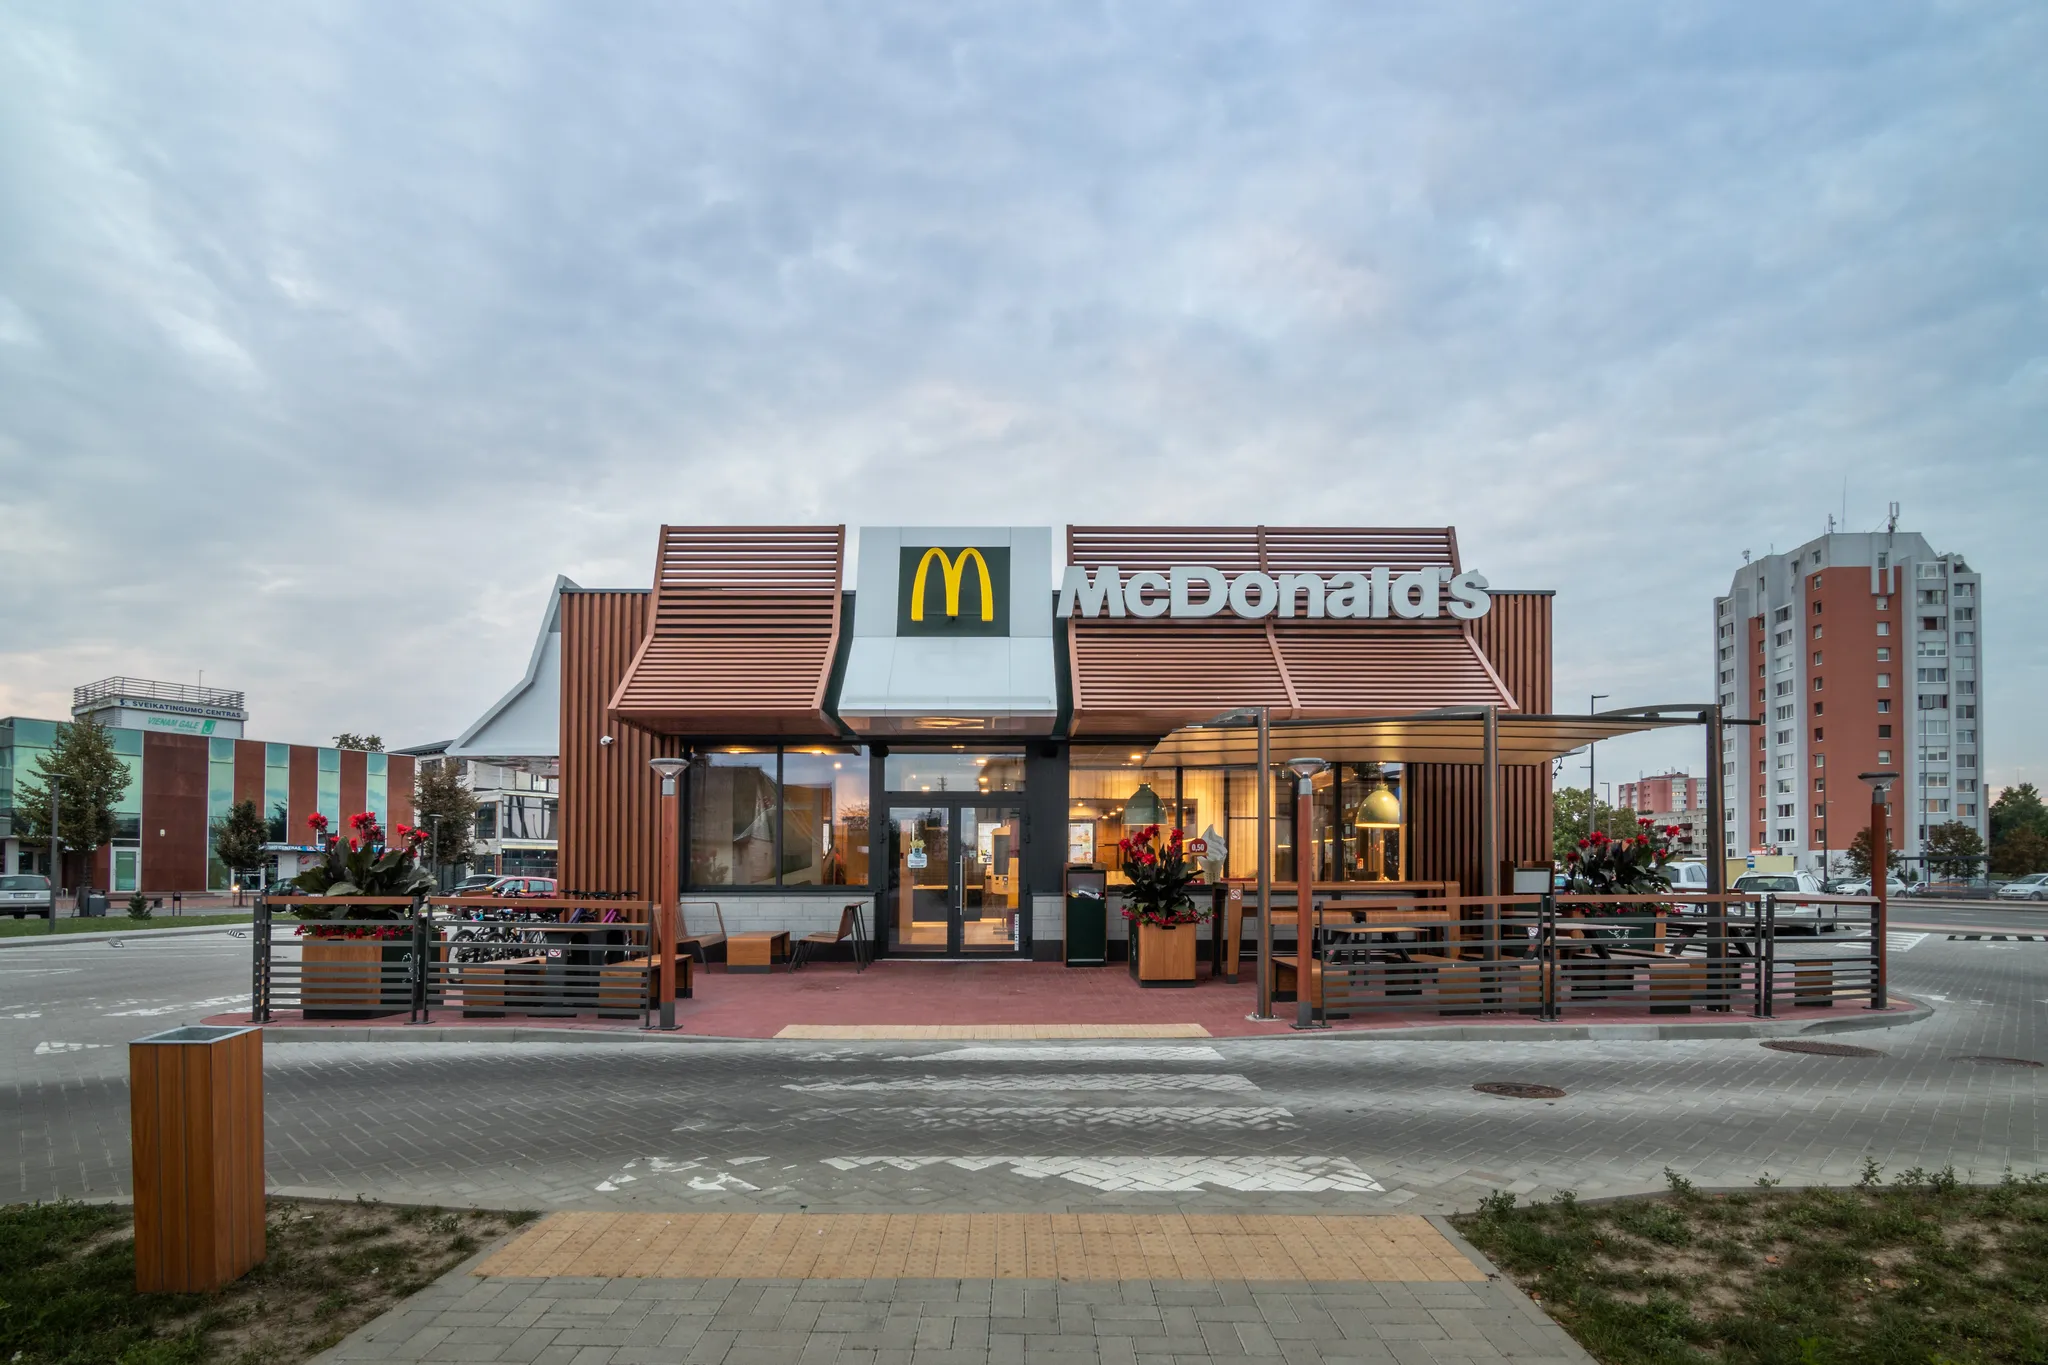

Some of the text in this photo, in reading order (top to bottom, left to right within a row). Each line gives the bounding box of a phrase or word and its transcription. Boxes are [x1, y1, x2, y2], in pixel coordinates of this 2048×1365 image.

[1056, 565, 1491, 619] McDonald's
[132, 700, 203, 714] SVEIKATINGUMO
[205, 708, 241, 718] CENTRAS
[1191, 843, 1205, 852] 0,50
